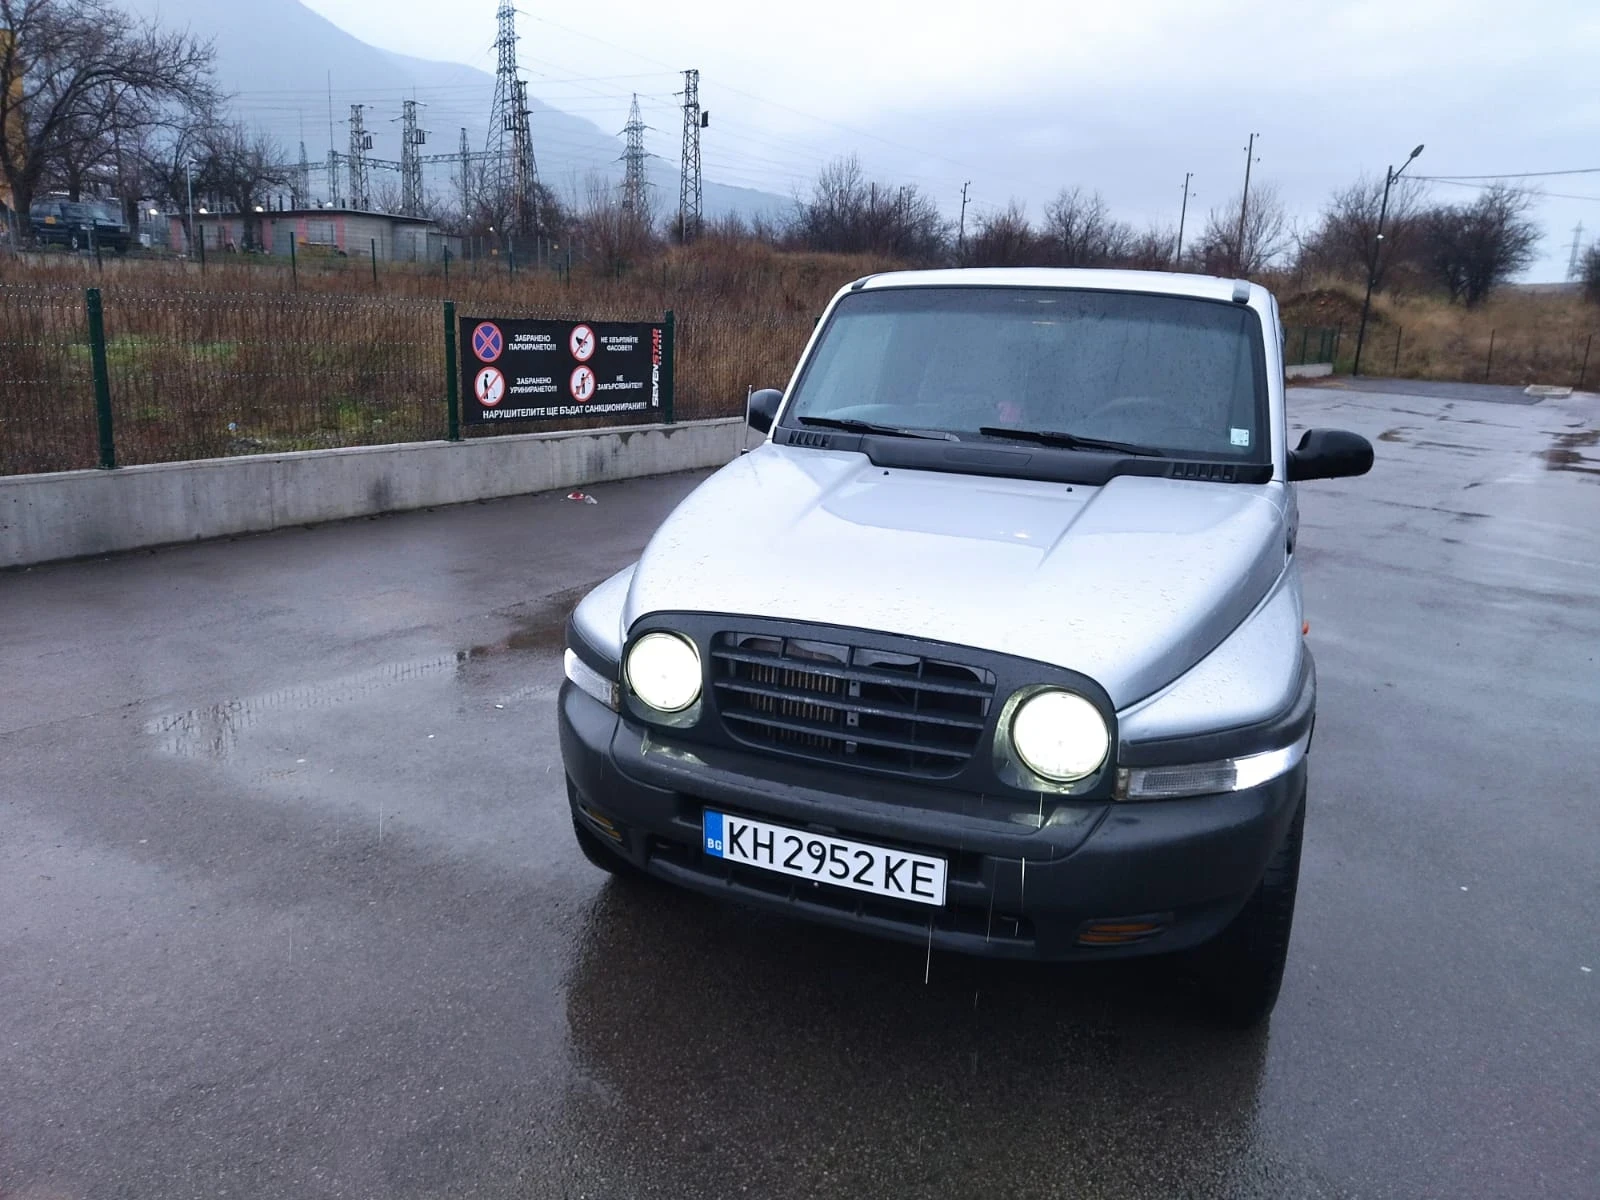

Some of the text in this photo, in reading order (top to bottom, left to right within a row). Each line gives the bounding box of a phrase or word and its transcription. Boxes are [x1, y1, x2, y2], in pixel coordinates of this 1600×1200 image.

[514, 334, 551, 342] ЗАБРАНЕНО
[516, 376, 552, 385] ЗАБРАНЕНО
[482, 407, 545, 419] НАРУШИТЕЛИТЕ
[546, 406, 559, 417] ЩЕ
[559, 405, 584, 415] БЪДАТ
[706, 837, 723, 851] BG
